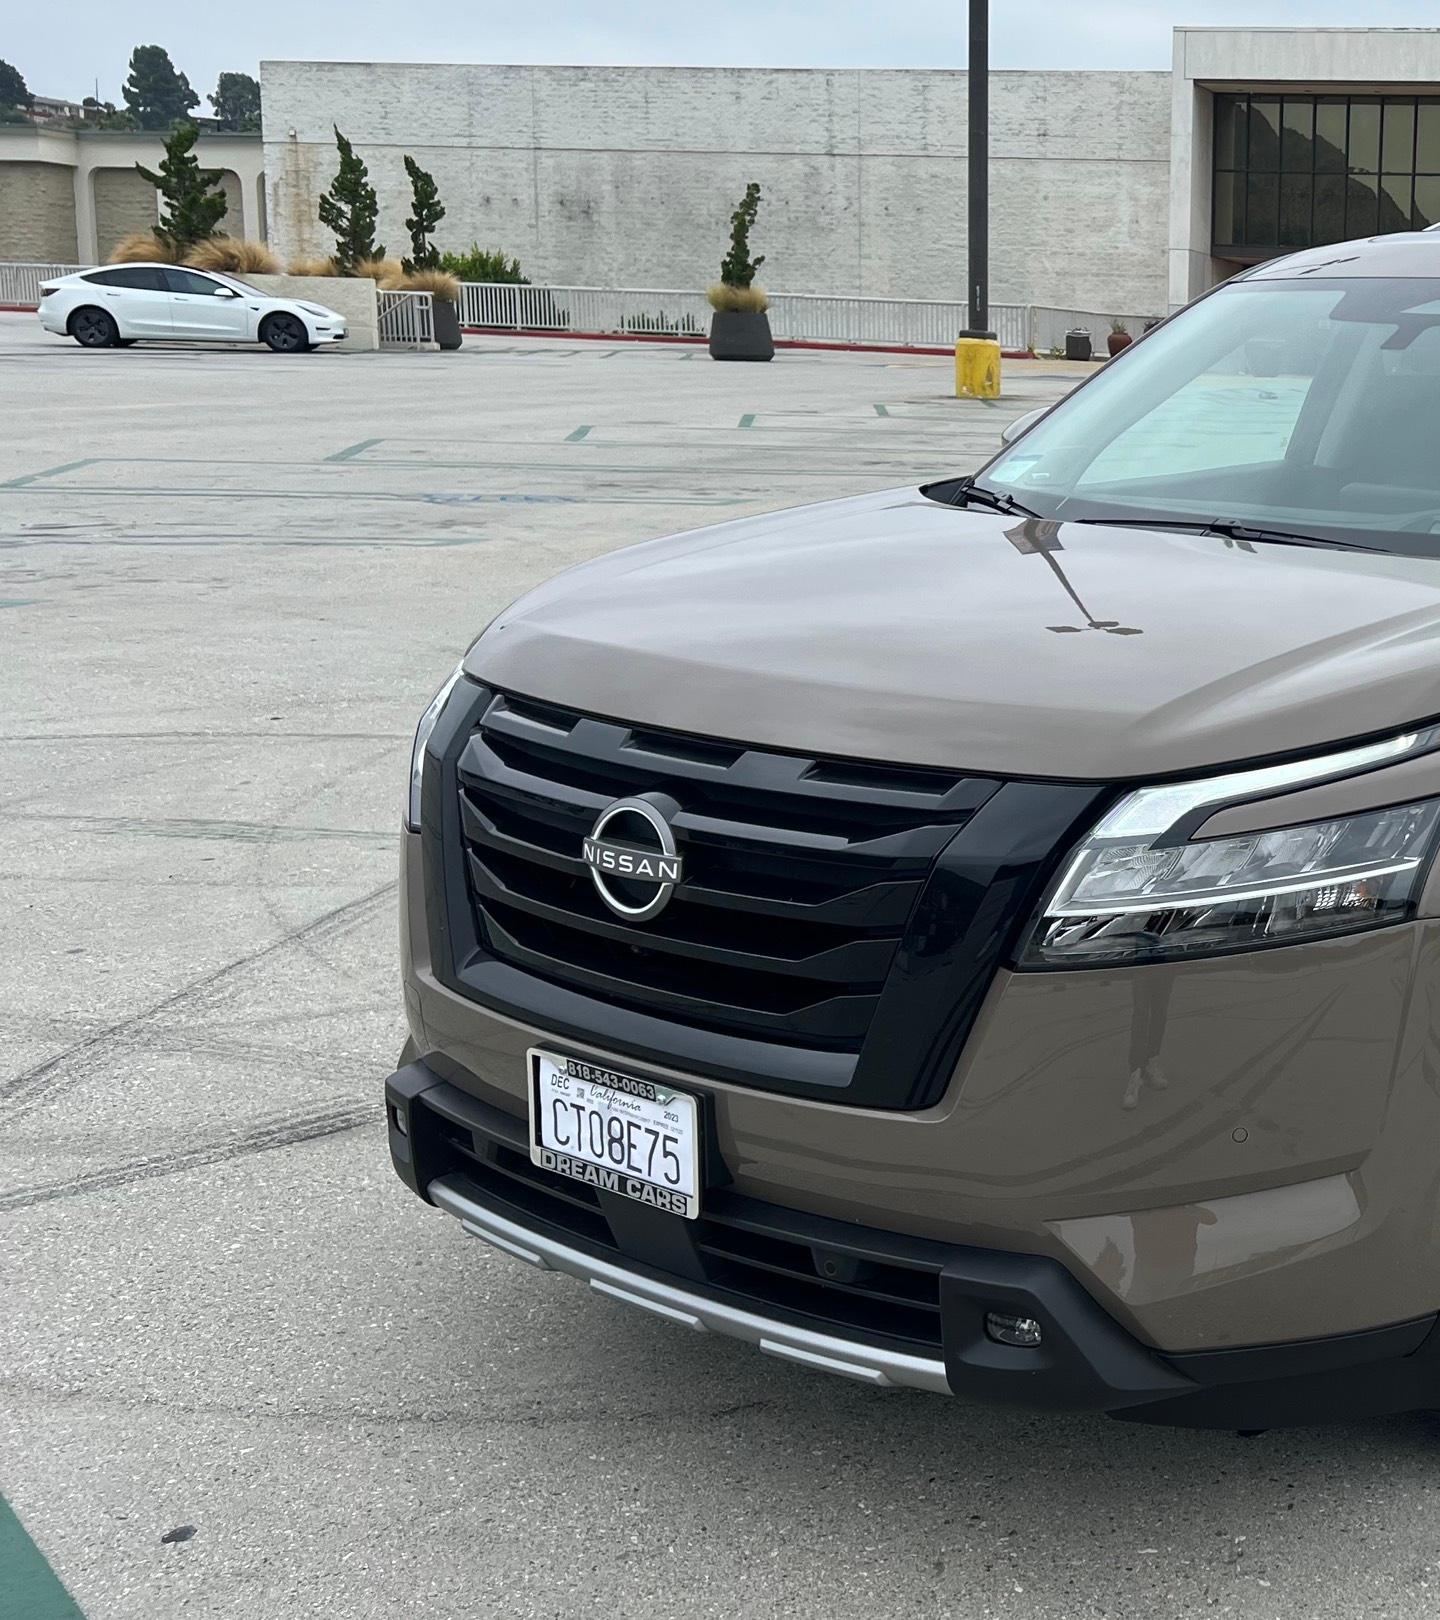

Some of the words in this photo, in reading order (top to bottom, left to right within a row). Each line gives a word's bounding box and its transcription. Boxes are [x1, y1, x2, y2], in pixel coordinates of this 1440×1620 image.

[583, 843, 678, 879] NISSAN
[551, 1073, 570, 1090] DEC
[568, 1062, 655, 1099] 818-543-0063
[590, 1084, 642, 1110] California
[663, 1110, 679, 1123] 2023
[552, 1098, 681, 1185] CT08E75
[542, 1150, 619, 1191] DREAM
[626, 1179, 687, 1214] CARS
